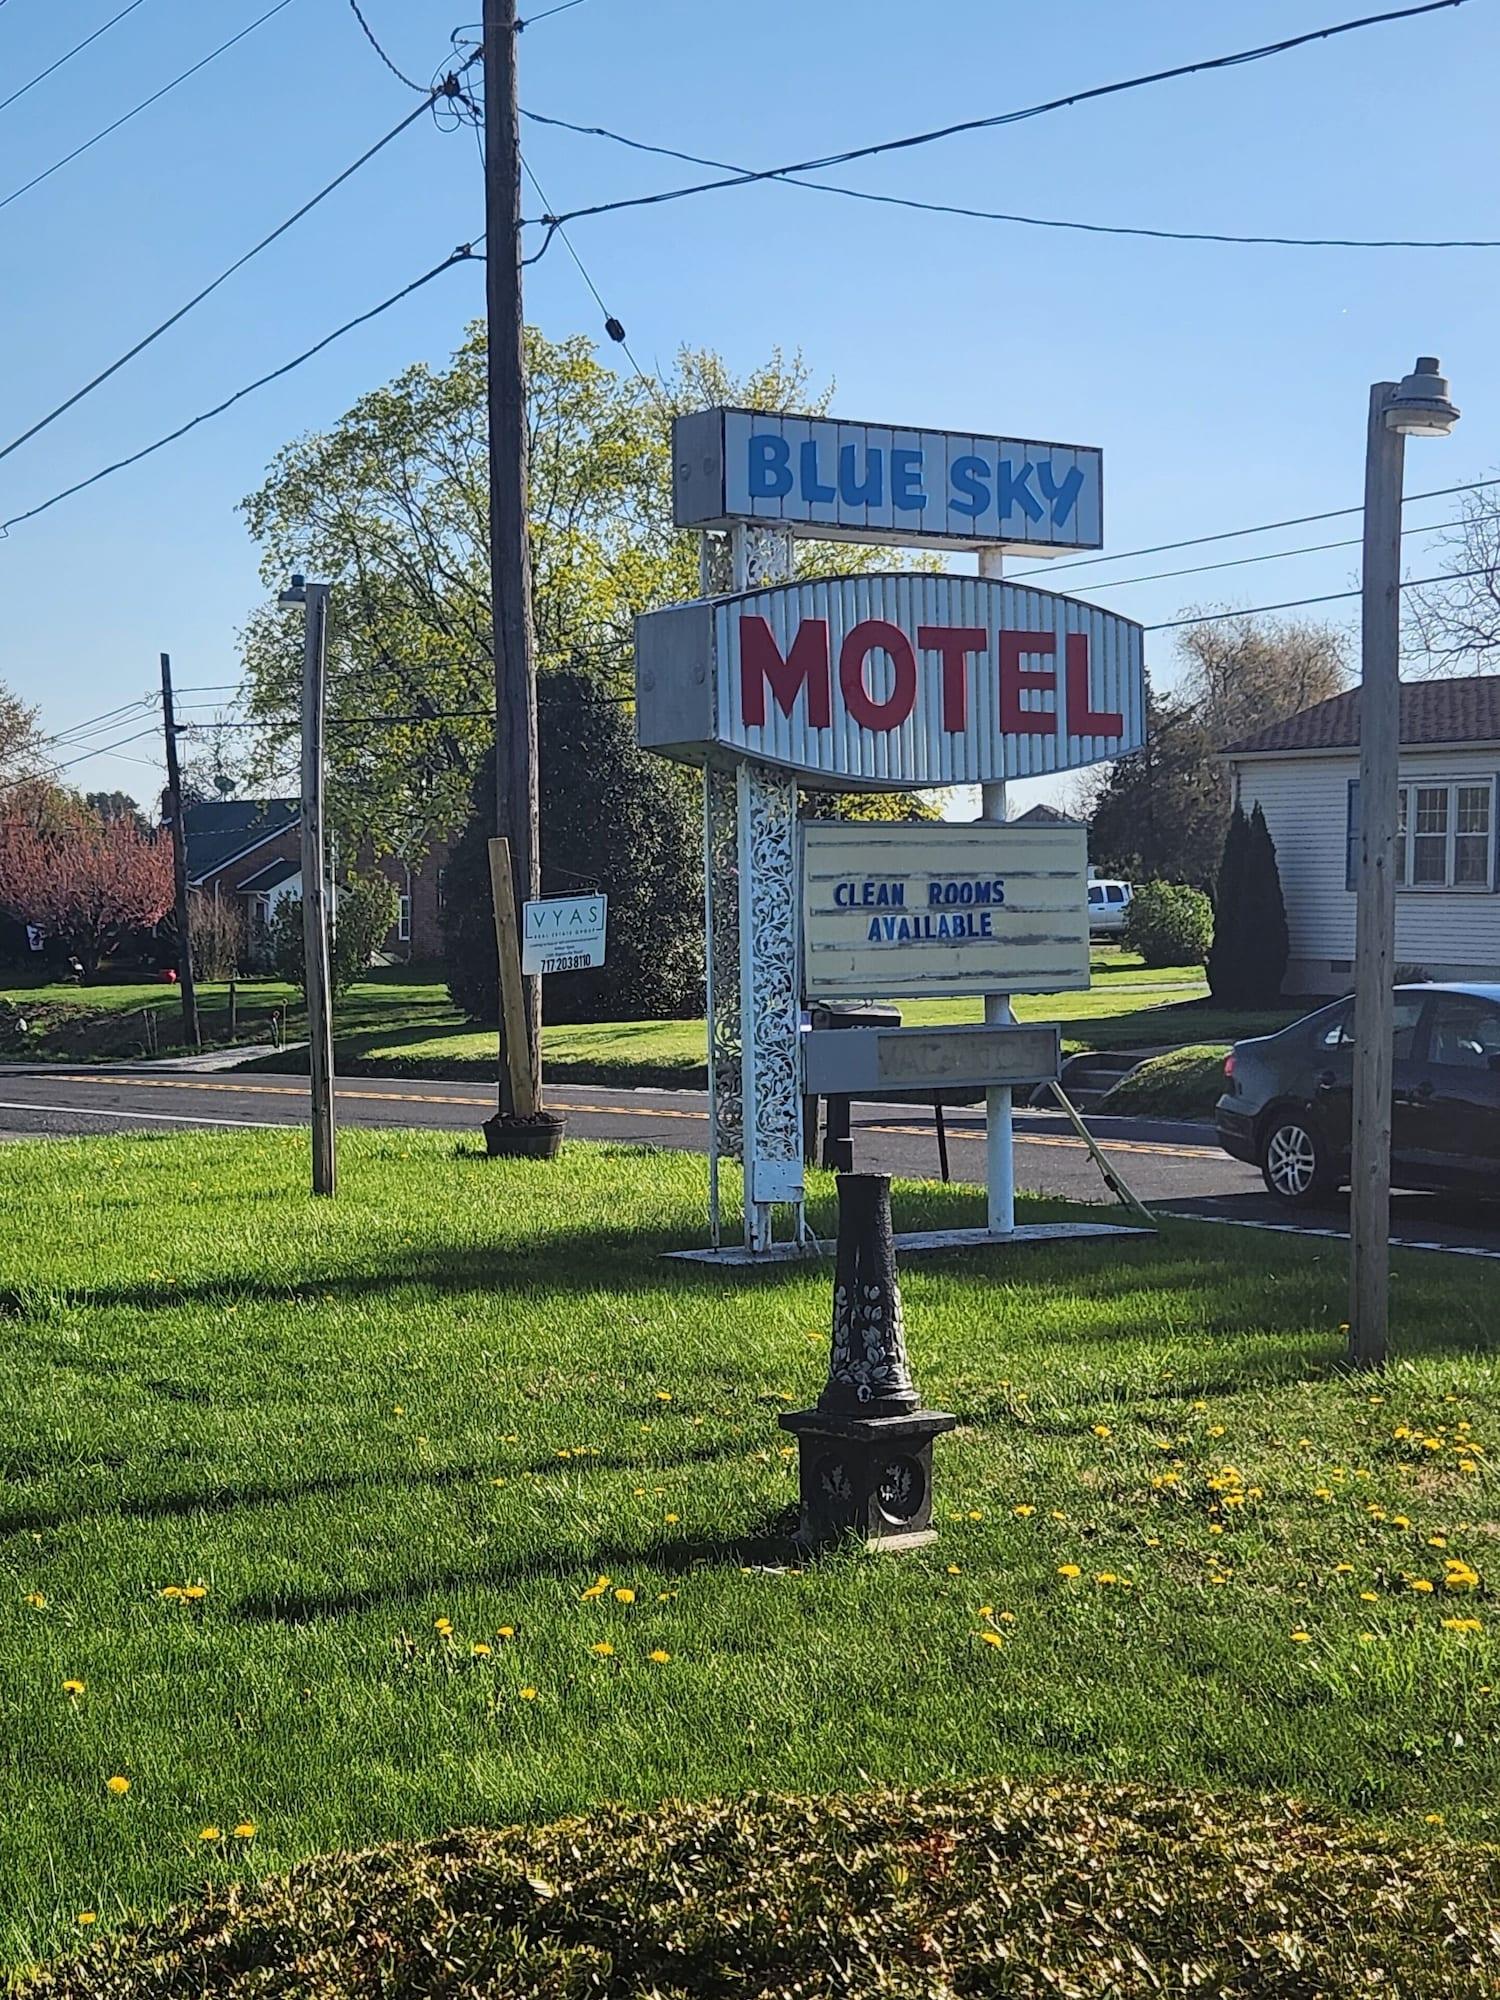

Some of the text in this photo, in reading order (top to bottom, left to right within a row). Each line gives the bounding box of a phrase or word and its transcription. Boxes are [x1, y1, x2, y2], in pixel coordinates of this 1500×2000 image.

[748, 434, 1085, 528] BLUE SKY
[739, 615, 1124, 737] MOTEL
[833, 880, 1006, 907] CLEAN ROOMS
[533, 906, 598, 928] VYAS
[867, 912, 993, 942] AVAILABLE
